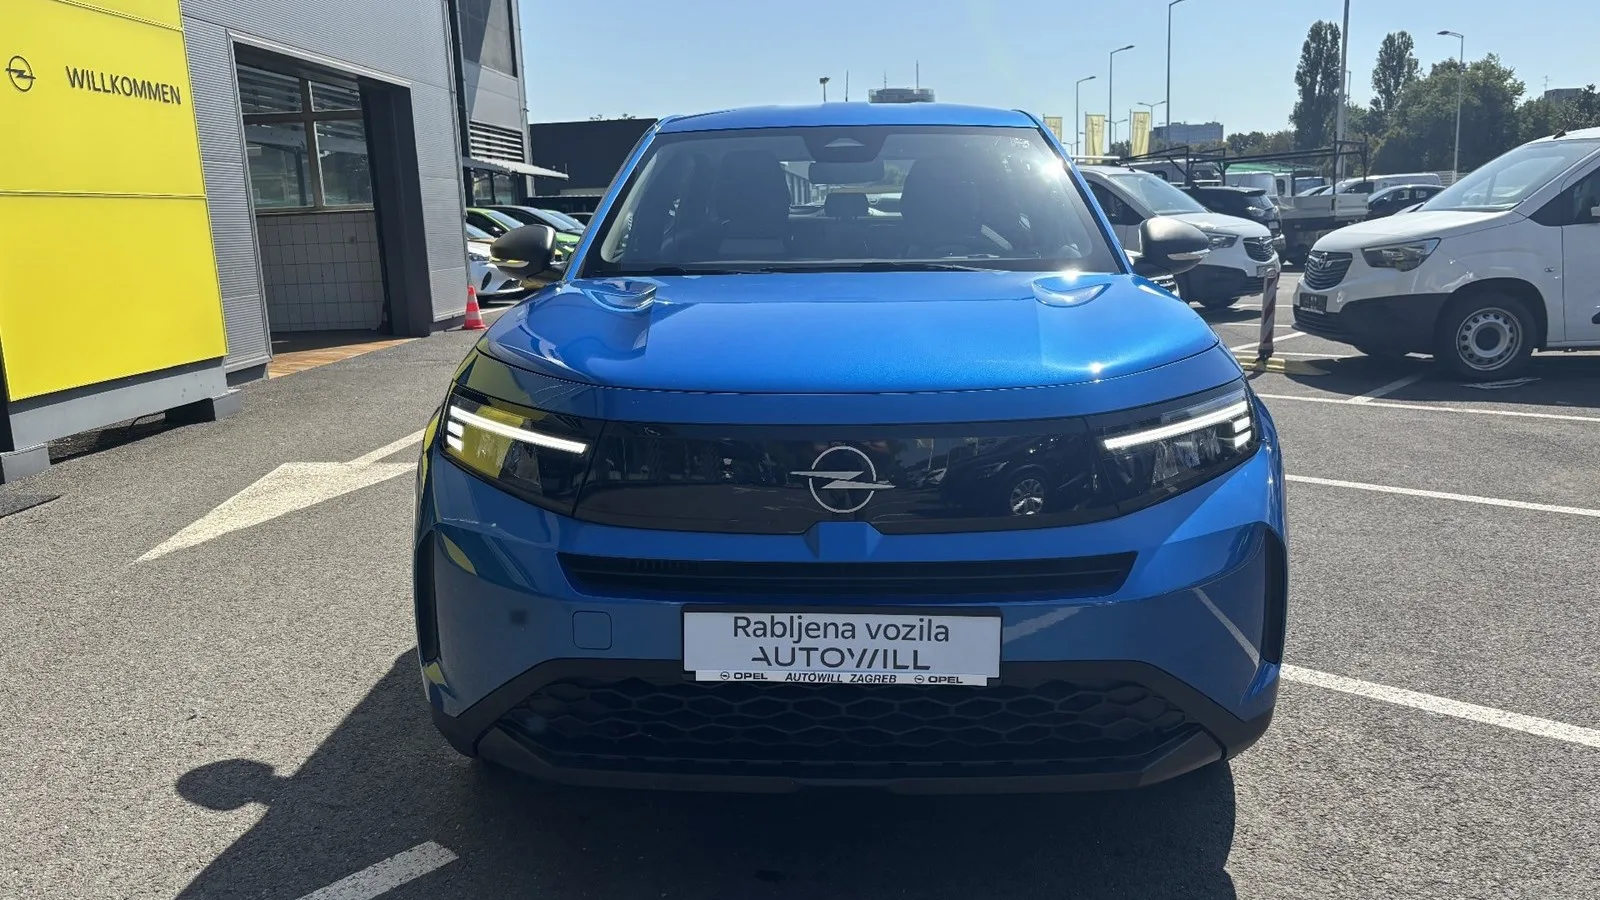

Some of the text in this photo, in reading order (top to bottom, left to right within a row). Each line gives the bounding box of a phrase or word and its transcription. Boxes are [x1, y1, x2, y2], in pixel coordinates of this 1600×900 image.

[65, 65, 182, 105] WILLKOMMEN
[733, 614, 950, 644] Rabljena vozila
[751, 646, 931, 671] AUTOWILL
[733, 672, 964, 684] OPEL AUTOWILL ZAGREB OPEL
